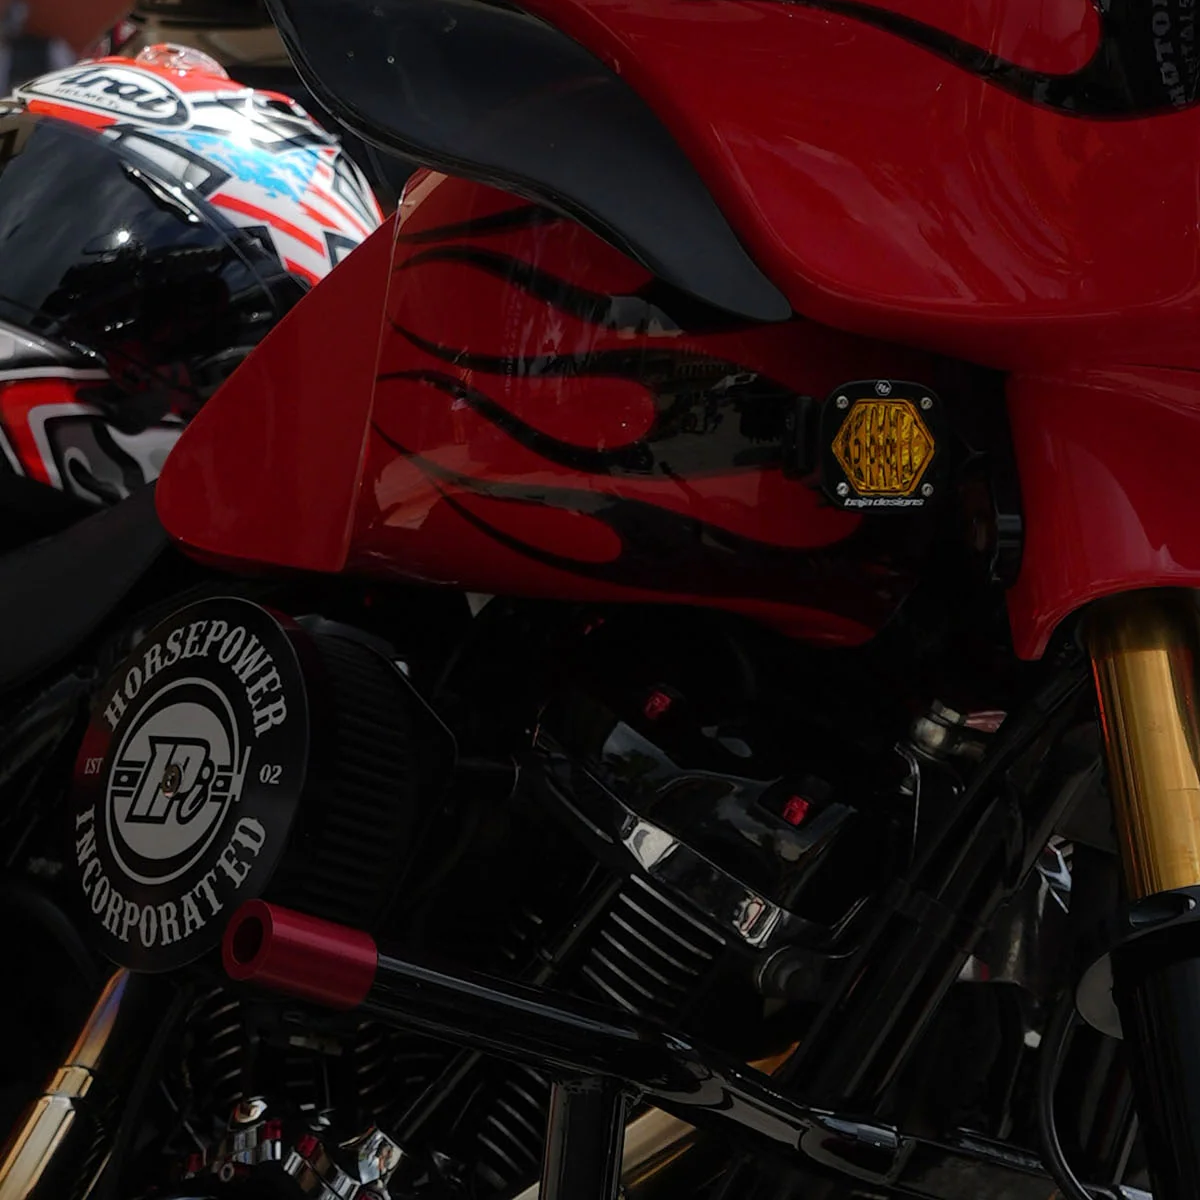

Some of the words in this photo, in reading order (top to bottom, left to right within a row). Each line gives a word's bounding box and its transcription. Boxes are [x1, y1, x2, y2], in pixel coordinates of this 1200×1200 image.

[60, 66, 178, 113] Arai
[844, 497, 873, 508] baja
[873, 497, 925, 507] designs
[102, 620, 288, 738] HORSEPOWER
[84, 757, 104, 775] EST
[259, 764, 283, 785] 02
[75, 804, 267, 949] INCORPORATED
